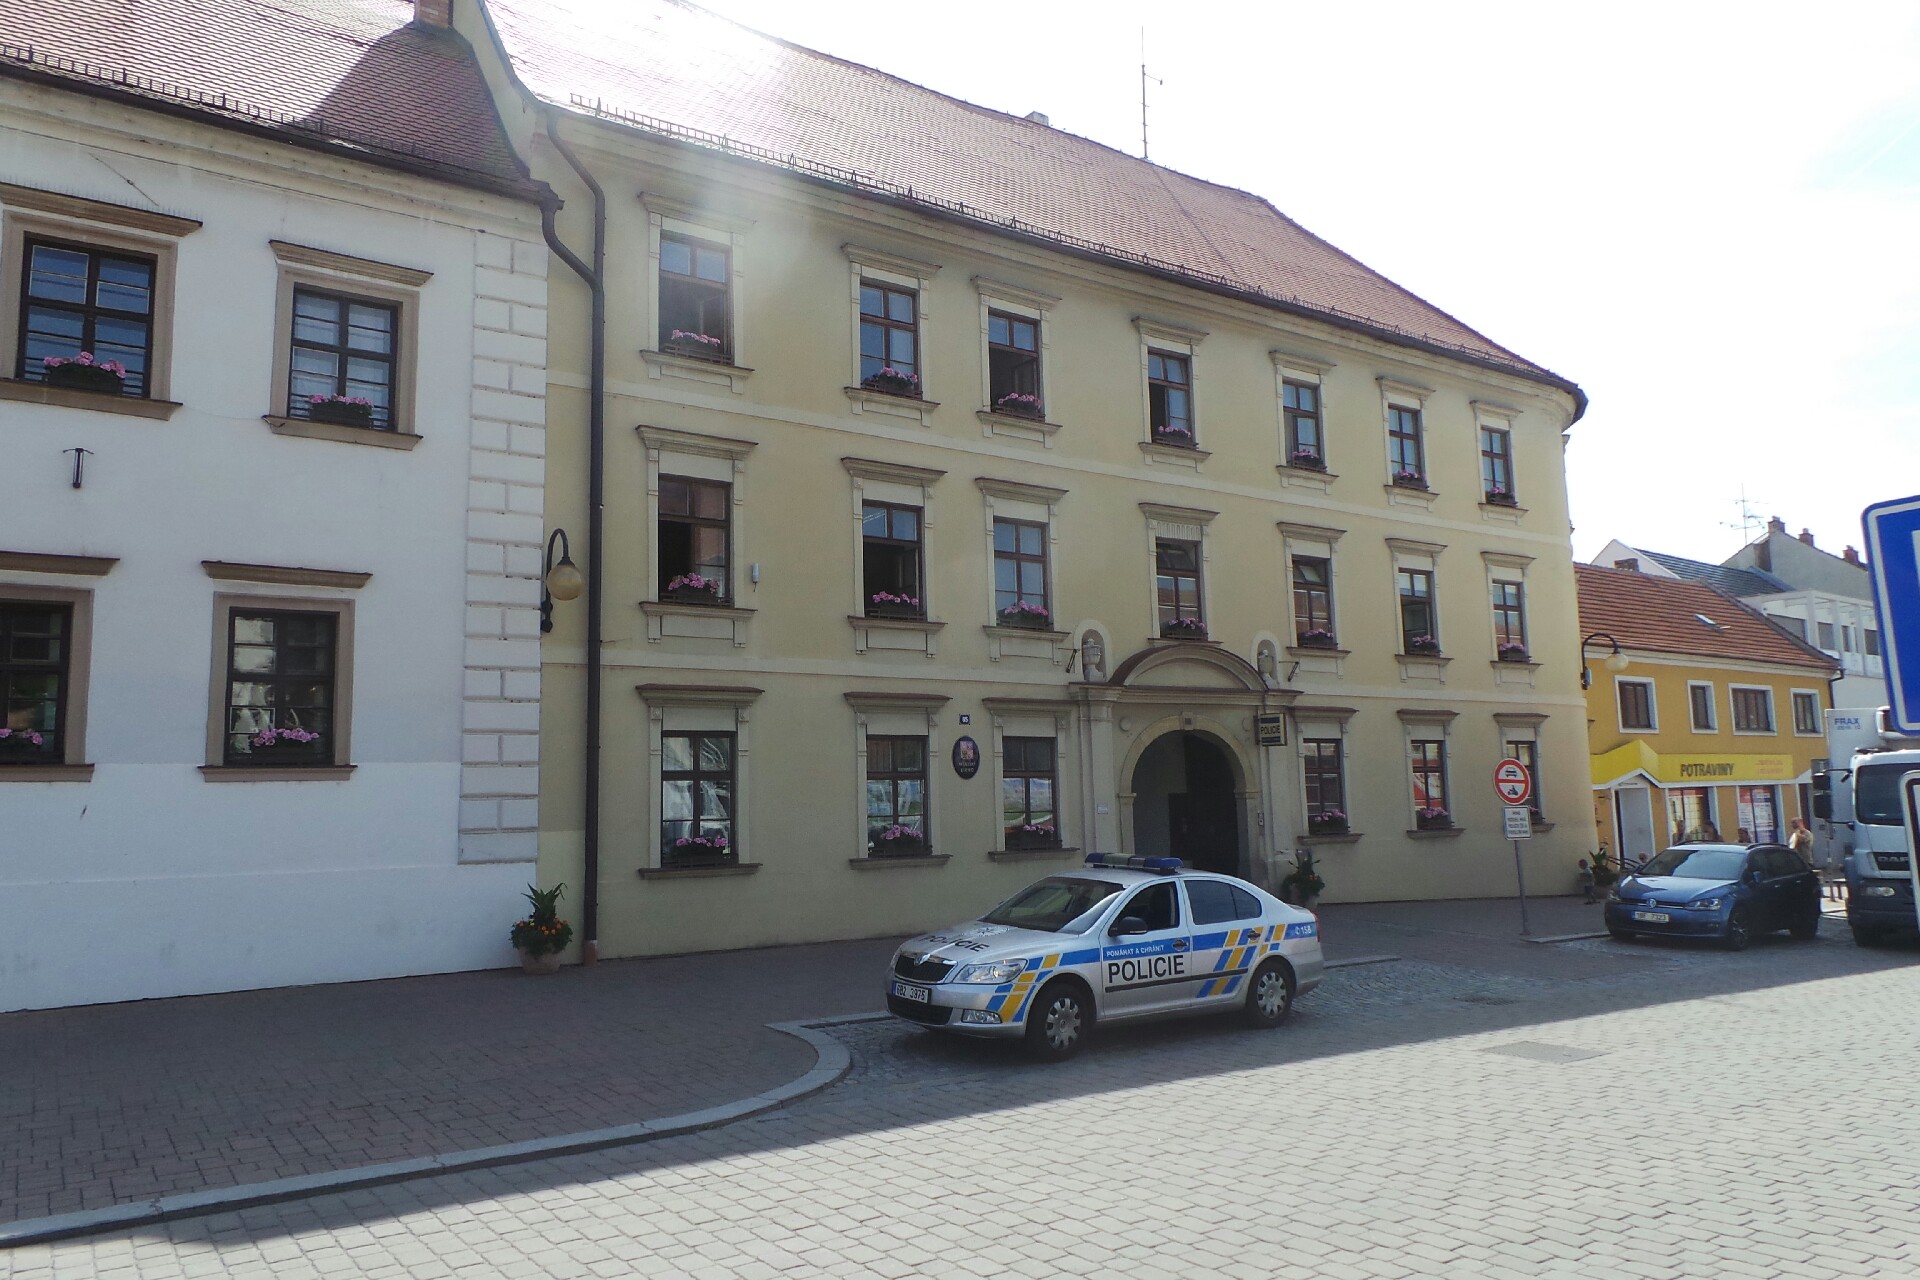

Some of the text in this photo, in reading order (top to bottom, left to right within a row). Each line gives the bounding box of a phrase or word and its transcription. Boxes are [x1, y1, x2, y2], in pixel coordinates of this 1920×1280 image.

[1834, 717, 1859, 725] FRAX
[1260, 725, 1281, 735] POLICIE
[1680, 763, 1735, 777] POTRAVINY
[1106, 948, 1134, 957] POMÁHAT
[1140, 944, 1164, 954] CHRÁNIT
[1108, 954, 1185, 983] POLICIE
